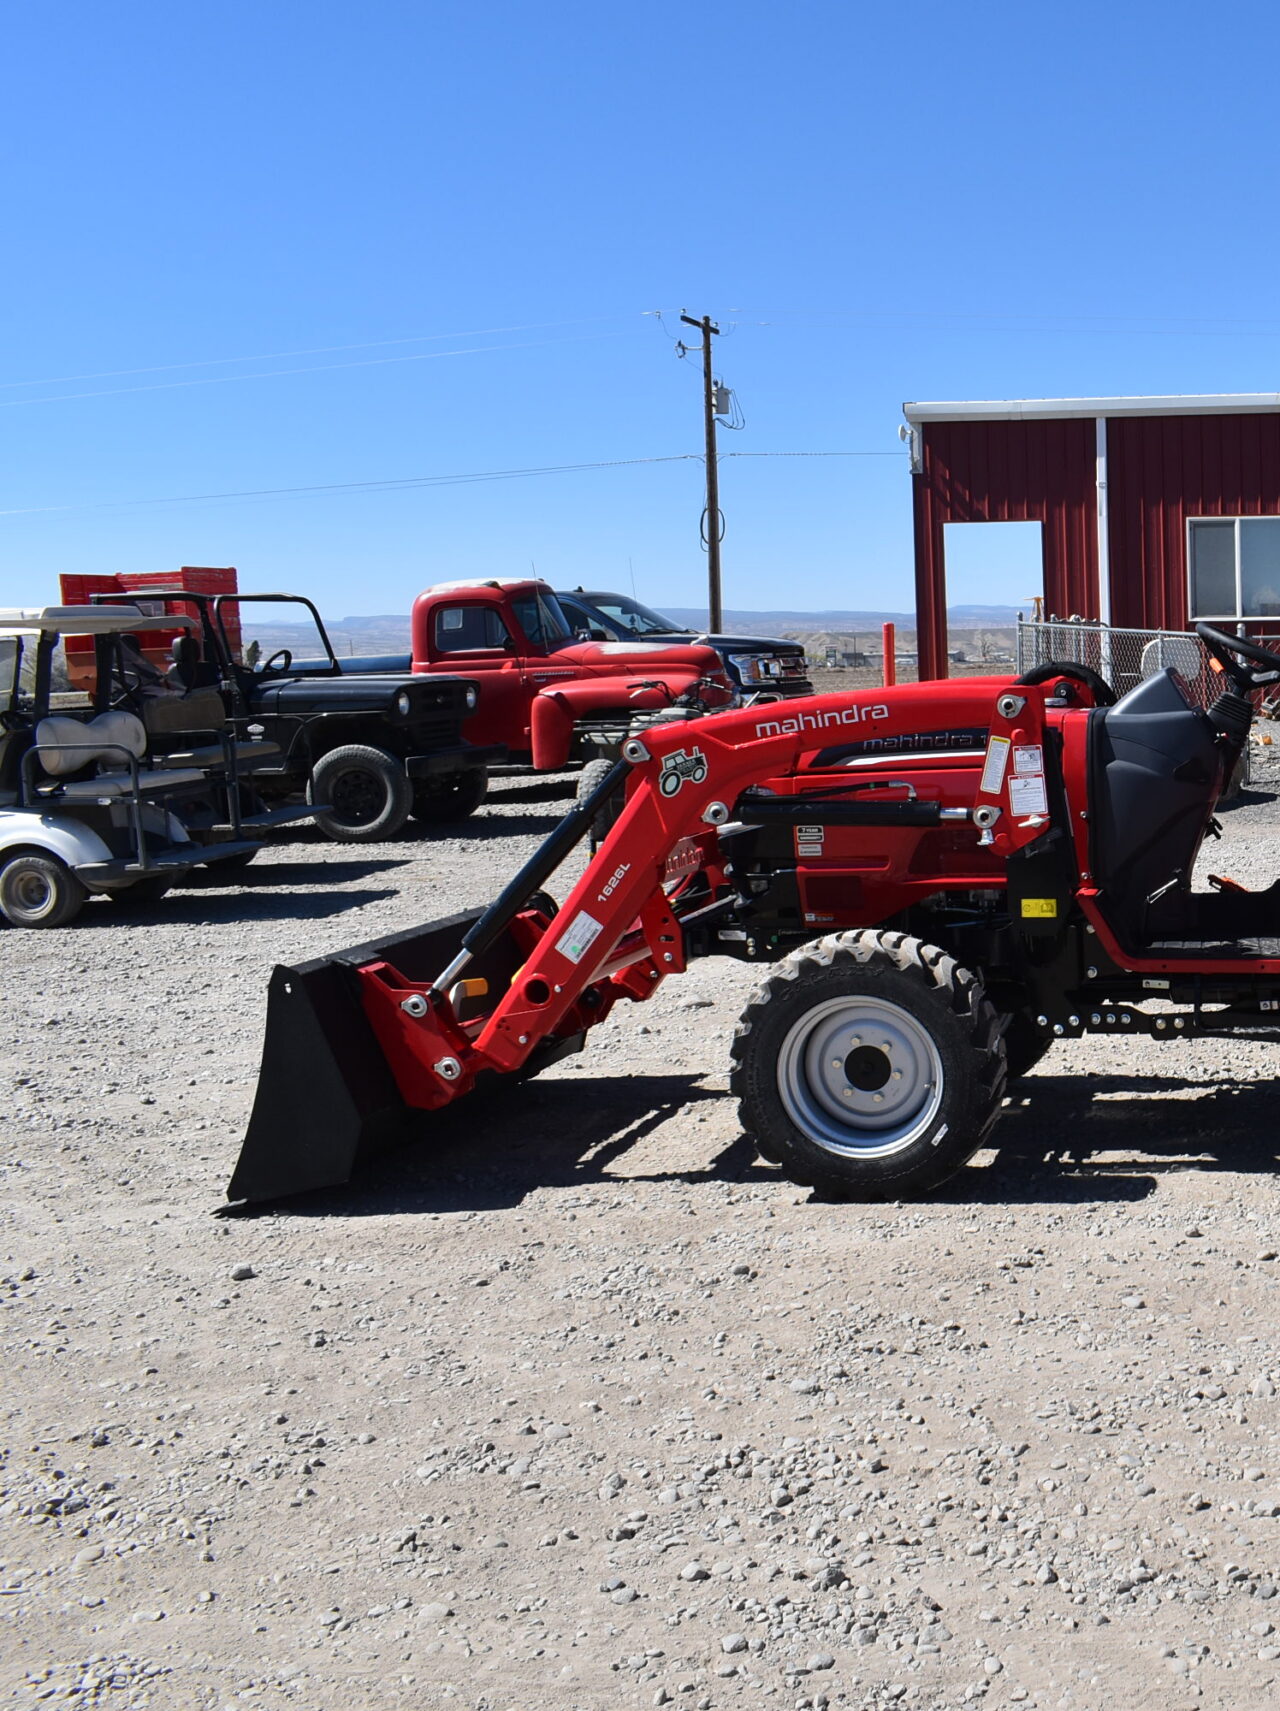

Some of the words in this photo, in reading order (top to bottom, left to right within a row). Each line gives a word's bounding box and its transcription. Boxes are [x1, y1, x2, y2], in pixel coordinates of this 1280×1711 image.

[755, 704, 889, 738] mahindra
[863, 733, 972, 750] mahindra
[598, 863, 631, 902] 1626L
